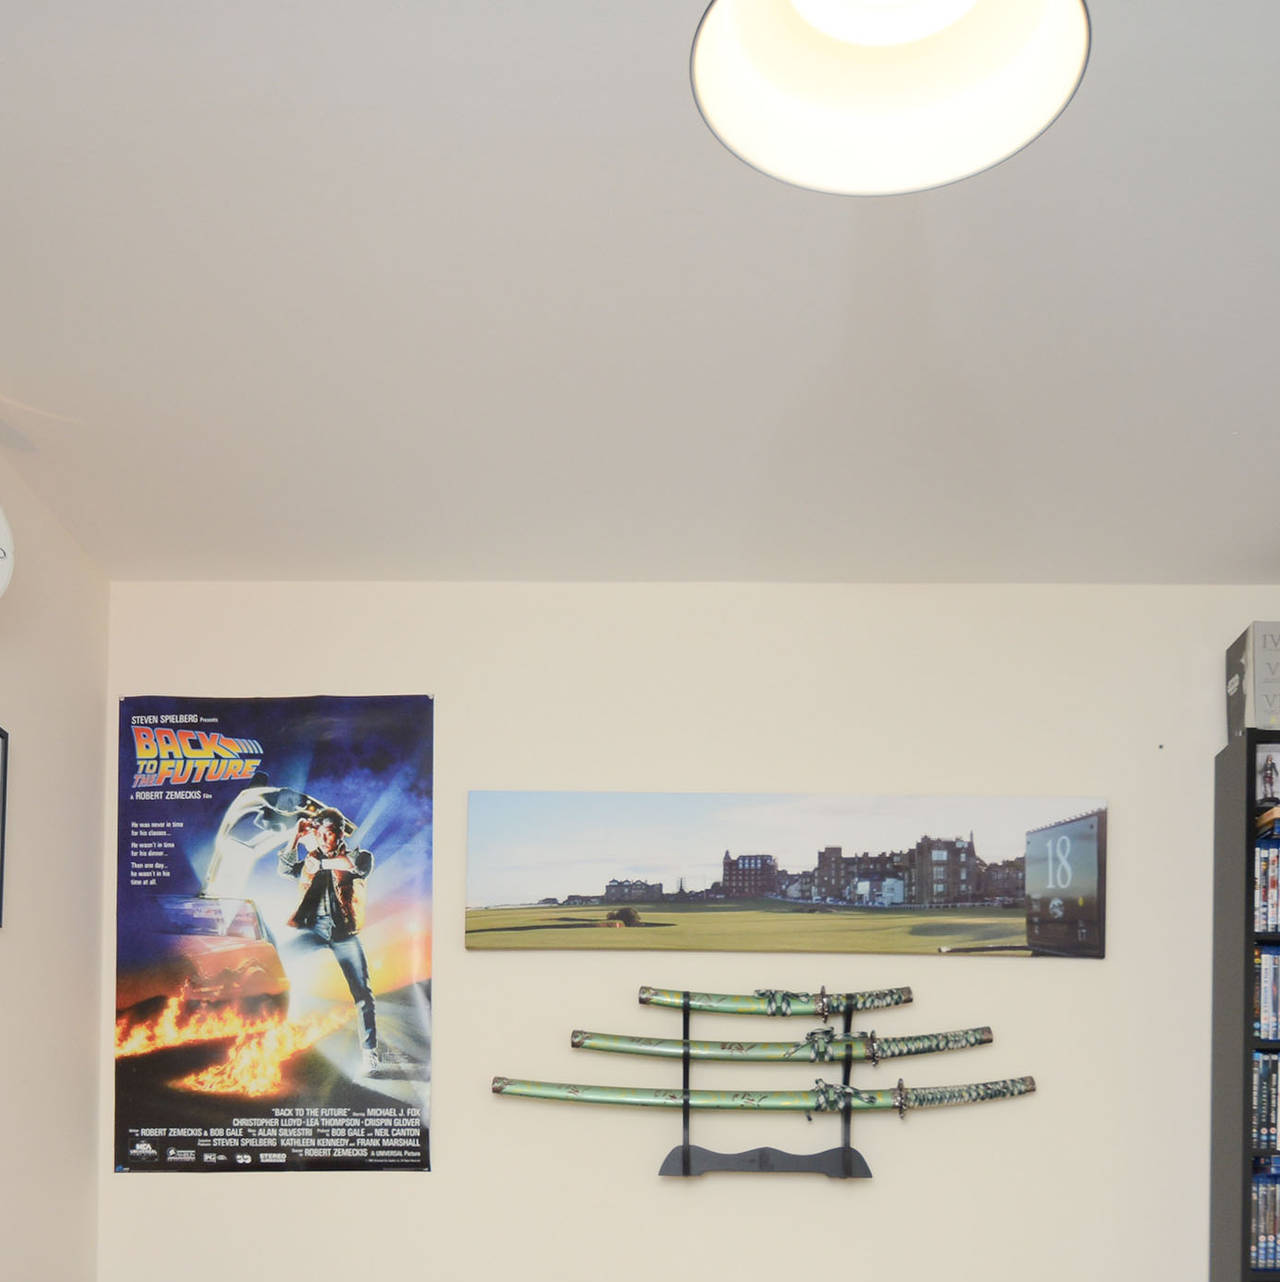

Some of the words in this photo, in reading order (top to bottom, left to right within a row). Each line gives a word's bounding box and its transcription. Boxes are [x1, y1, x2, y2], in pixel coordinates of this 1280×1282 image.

[131, 715, 158, 725] STEVEN
[160, 714, 199, 724] SPIELBERG
[131, 725, 242, 759] BACK
[137, 760, 158, 774] TO
[154, 759, 262, 785] FUTURE
[132, 774, 156, 788] THE
[135, 791, 164, 800] ROBERT
[165, 790, 201, 800] ZEMECKIS
[1045, 835, 1072, 889] 18
[294, 1108, 305, 1117] TO
[305, 1108, 319, 1117] THE
[367, 1108, 397, 1117] MICHAEL
[407, 1108, 421, 1117] FOX
[232, 1118, 279, 1127] CHRISTOPHER
[280, 1118, 302, 1127] LLOYD
[306, 1118, 319, 1127] LEA
[321, 1118, 361, 1127] THOMPSON
[364, 1118, 392, 1127] CRISPIN
[393, 1118, 421, 1127] GLOVER
[140, 1128, 167, 1137] ROBERT
[168, 1128, 202, 1137] ZEMECKIS
[209, 1128, 224, 1137] BOB
[225, 1128, 243, 1137] GALE
[258, 1128, 277, 1137] ALAN
[278, 1128, 313, 1137] SILVESTRI
[331, 1128, 347, 1137] BOB
[347, 1128, 366, 1137] GALE
[374, 1128, 389, 1137] NEIL
[391, 1128, 421, 1137] CANTON
[212, 1138, 239, 1147] STEVEN
[240, 1138, 277, 1147] SPIELBERG
[280, 1138, 316, 1147] KATHLEEN
[316, 1138, 349, 1147] KENNEDY
[356, 1138, 381, 1147] FRANK
[382, 1138, 421, 1147] MARSHALL
[304, 1148, 331, 1157] ROBERT
[333, 1148, 368, 1157] ZEMECKIS
